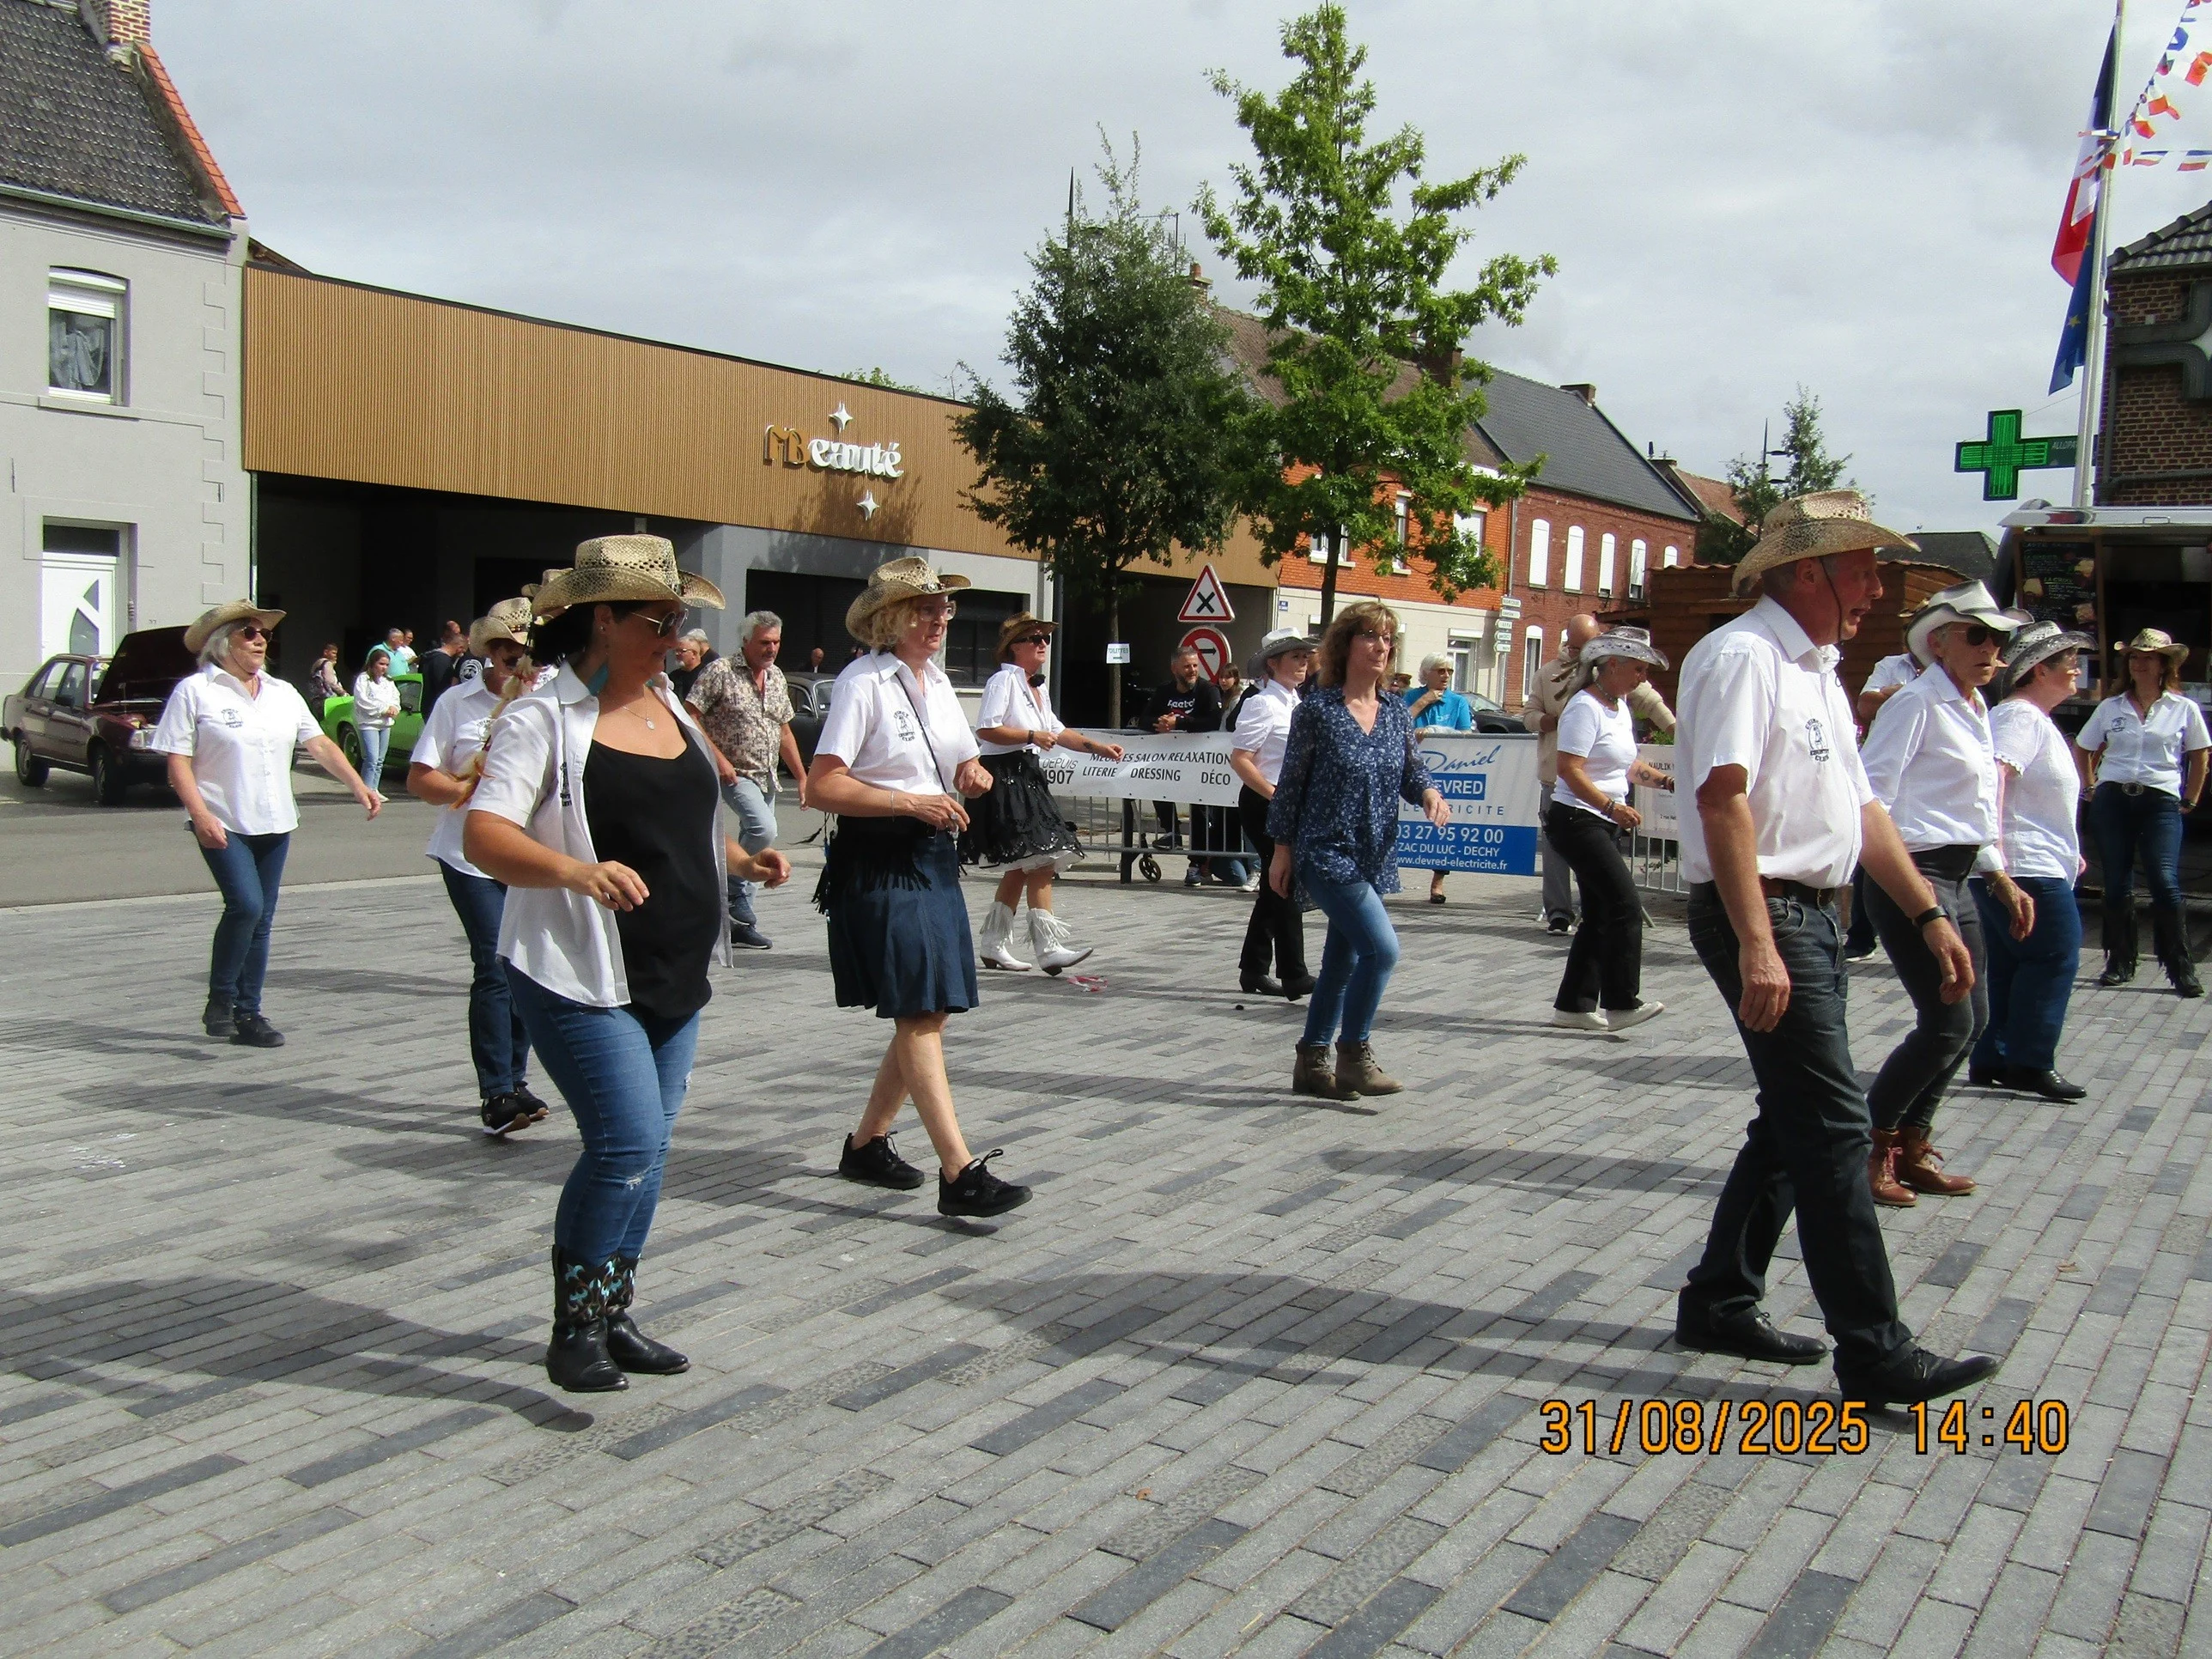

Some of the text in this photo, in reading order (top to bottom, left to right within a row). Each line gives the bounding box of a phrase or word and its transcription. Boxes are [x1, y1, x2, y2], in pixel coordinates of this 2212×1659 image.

[1042, 757, 1079, 769] DEPUIS
[1090, 751, 1231, 765] MEUES SALON RELAXATION
[1421, 744, 1502, 773] Daniel
[1082, 766, 1231, 786] LITERIE DRESSING DÉCO
[1434, 779, 1483, 795] VRED
[1403, 803, 1504, 816] LERICITE
[1414, 825, 1433, 840] 27
[1437, 826, 1455, 842] 95
[1461, 828, 1479, 842] 92
[1484, 829, 1504, 844] 00
[1398, 842, 1418, 853] ZAC
[1419, 843, 1434, 854] DU
[1437, 844, 1456, 855] LUC
[1463, 846, 1501, 858] DECHY
[1396, 855, 1508, 870] ww.devred-electricite.fr
